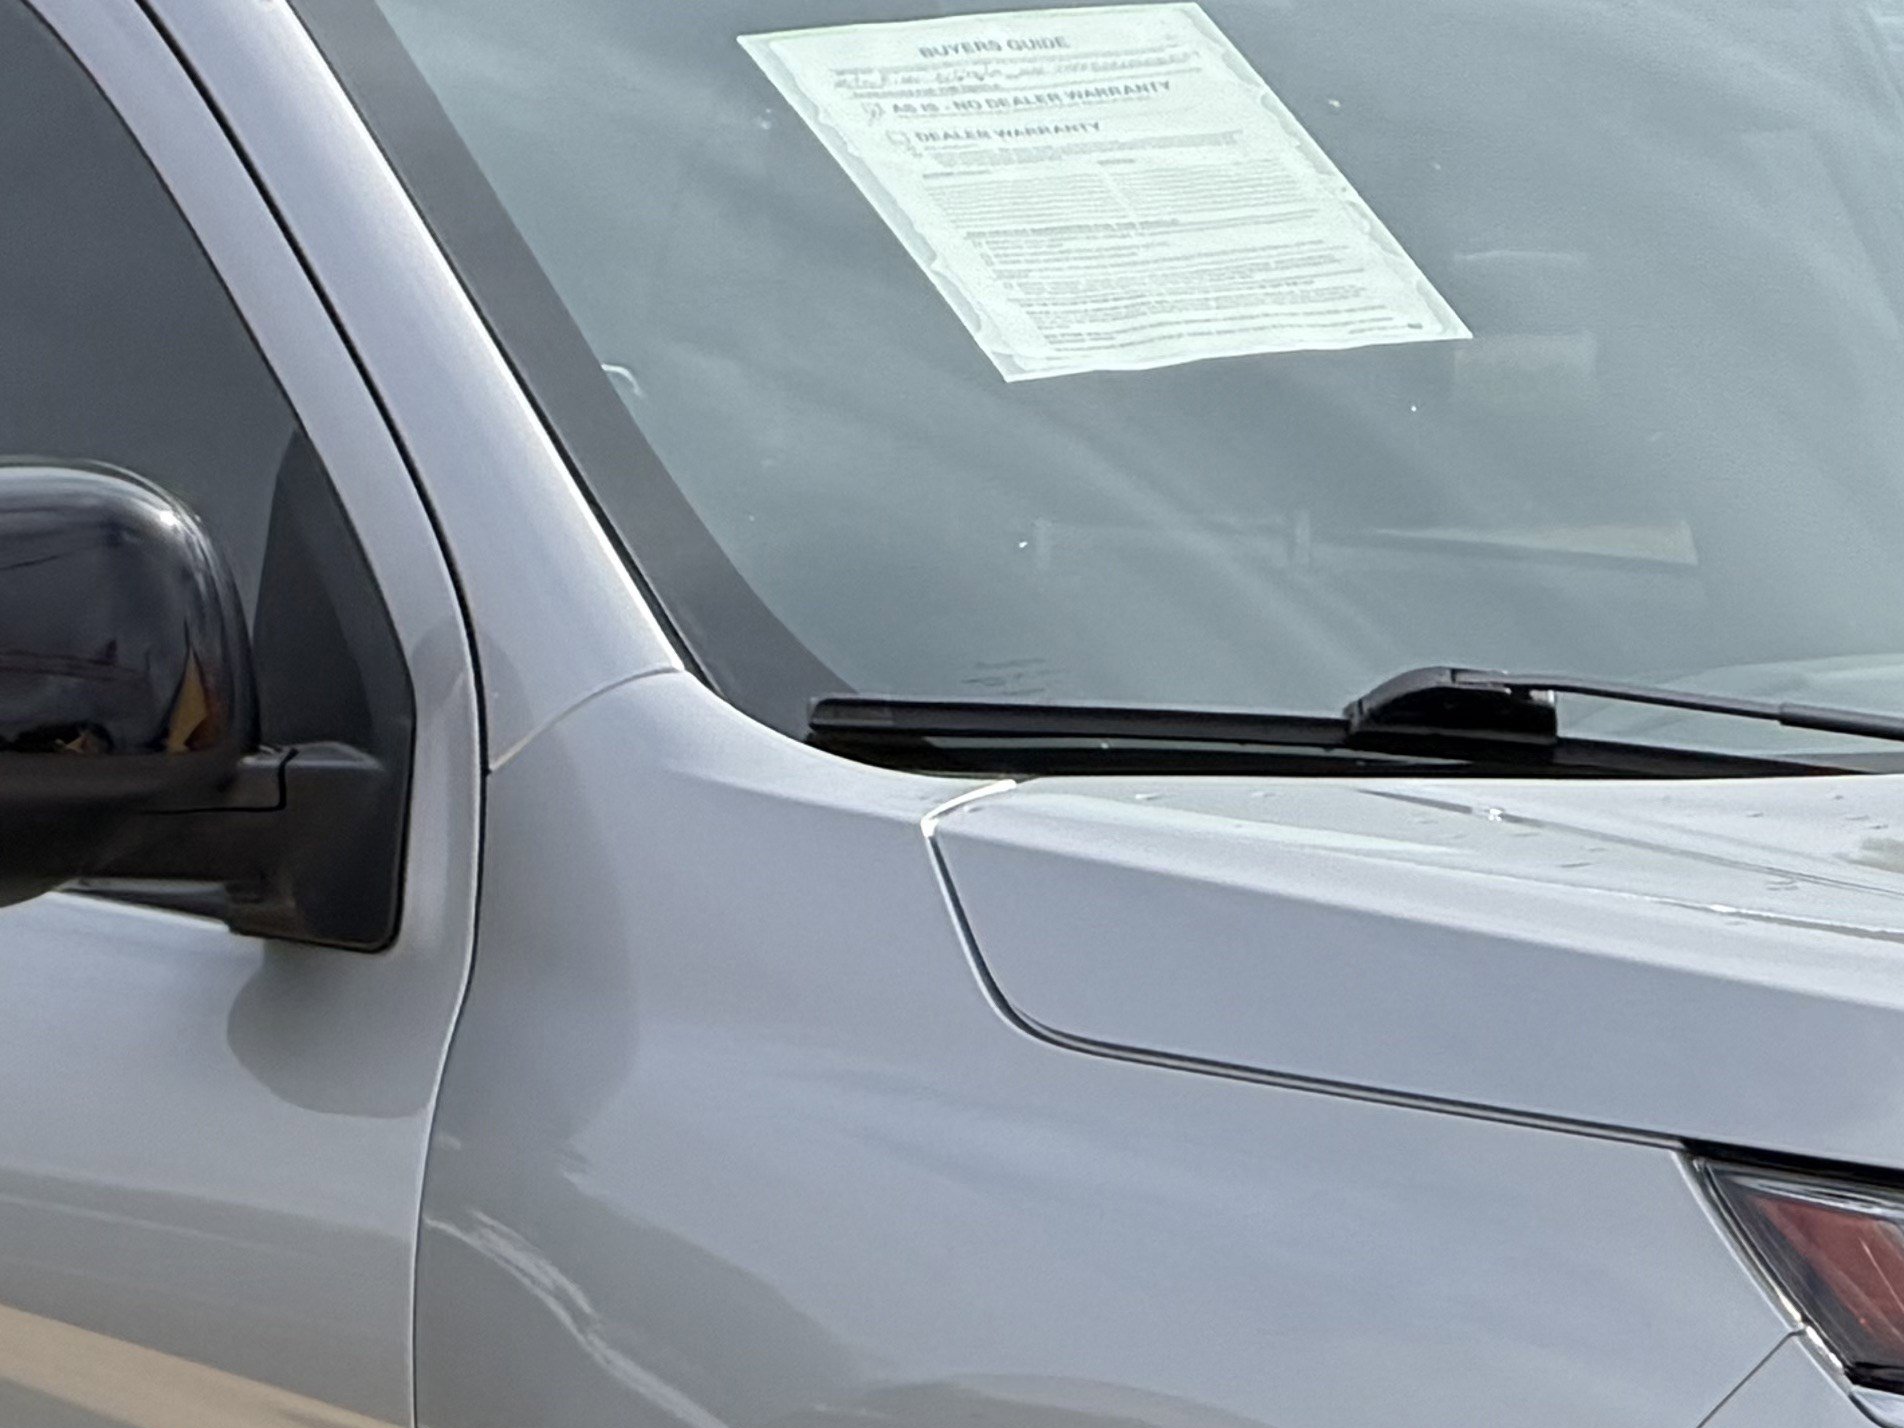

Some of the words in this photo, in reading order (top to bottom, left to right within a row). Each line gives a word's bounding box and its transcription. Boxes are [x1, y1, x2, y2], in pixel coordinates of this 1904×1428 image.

[917, 39, 1003, 59] BUYERS
[1006, 35, 1071, 51] GUIDE
[952, 99, 982, 111] NO
[984, 92, 1062, 108] DEALER
[1063, 79, 1170, 101] WARRANTY
[914, 127, 992, 143] DEALER
[993, 120, 1101, 138] WARRANTY
